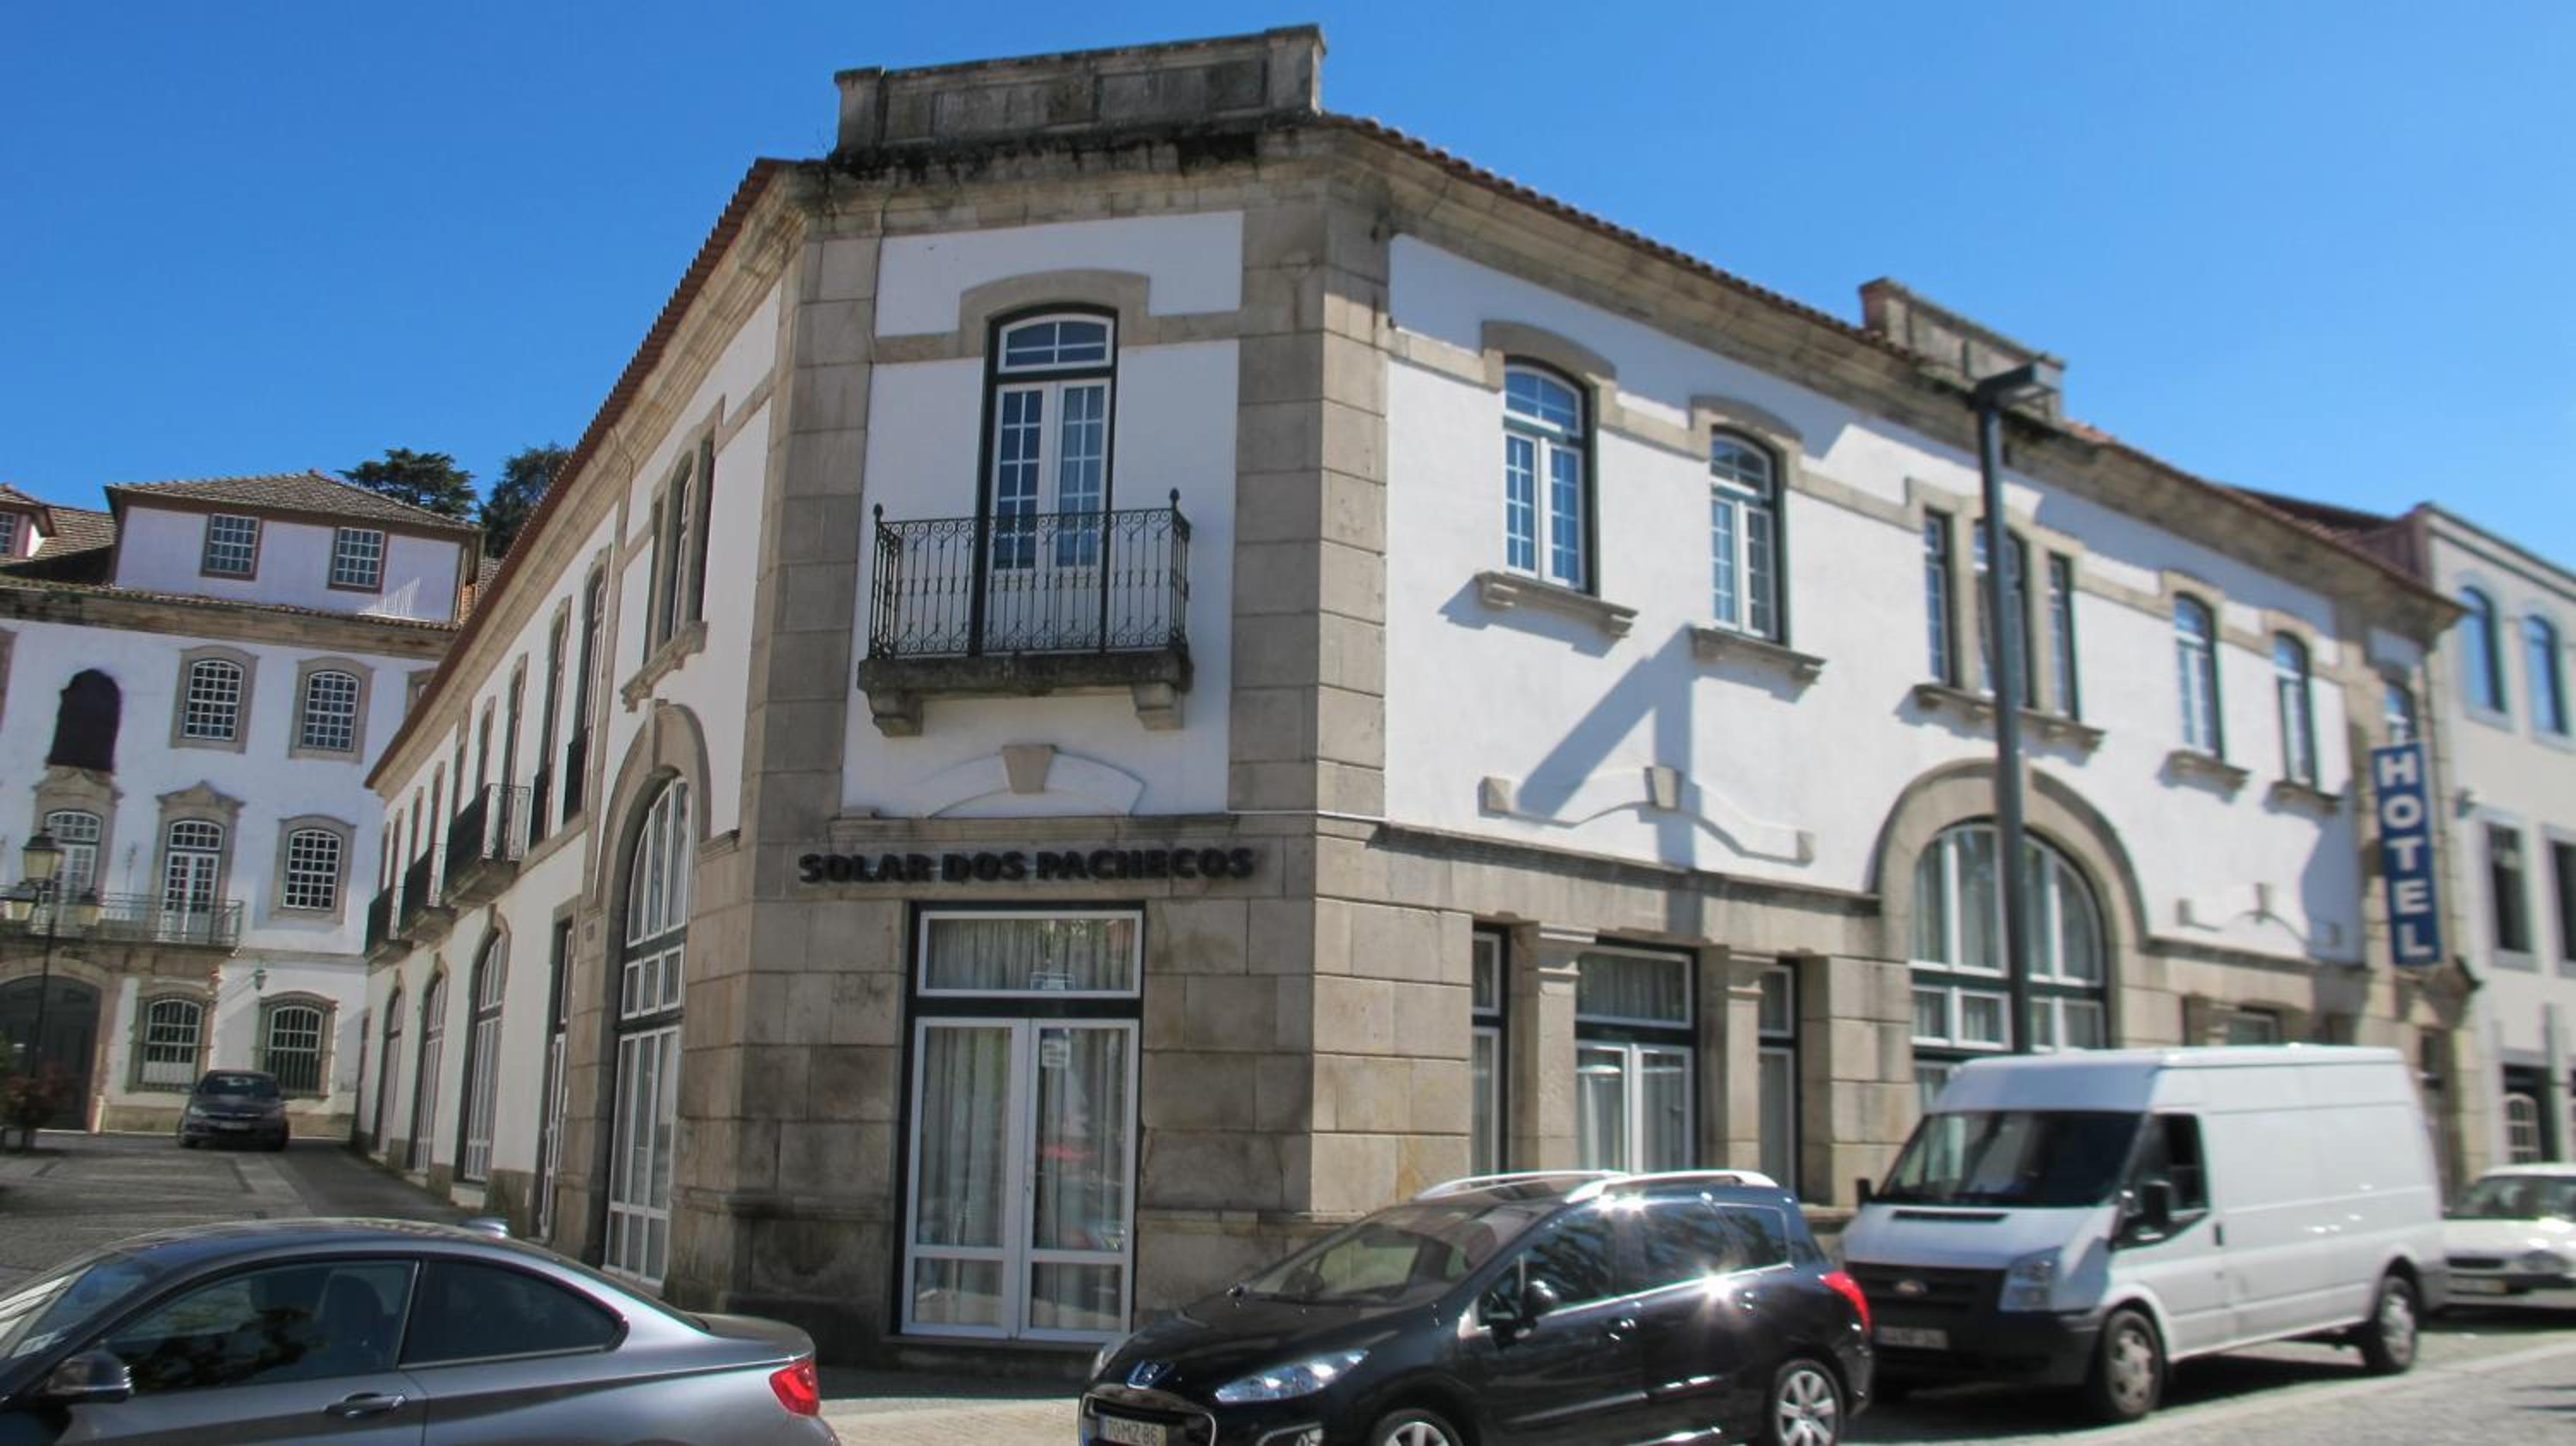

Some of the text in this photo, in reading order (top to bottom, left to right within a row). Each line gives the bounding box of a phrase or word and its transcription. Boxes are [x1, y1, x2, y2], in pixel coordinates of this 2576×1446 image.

[799, 848, 1255, 883] SOLAR DOS PACHECOS
[2377, 750, 2433, 957] HOTEL
